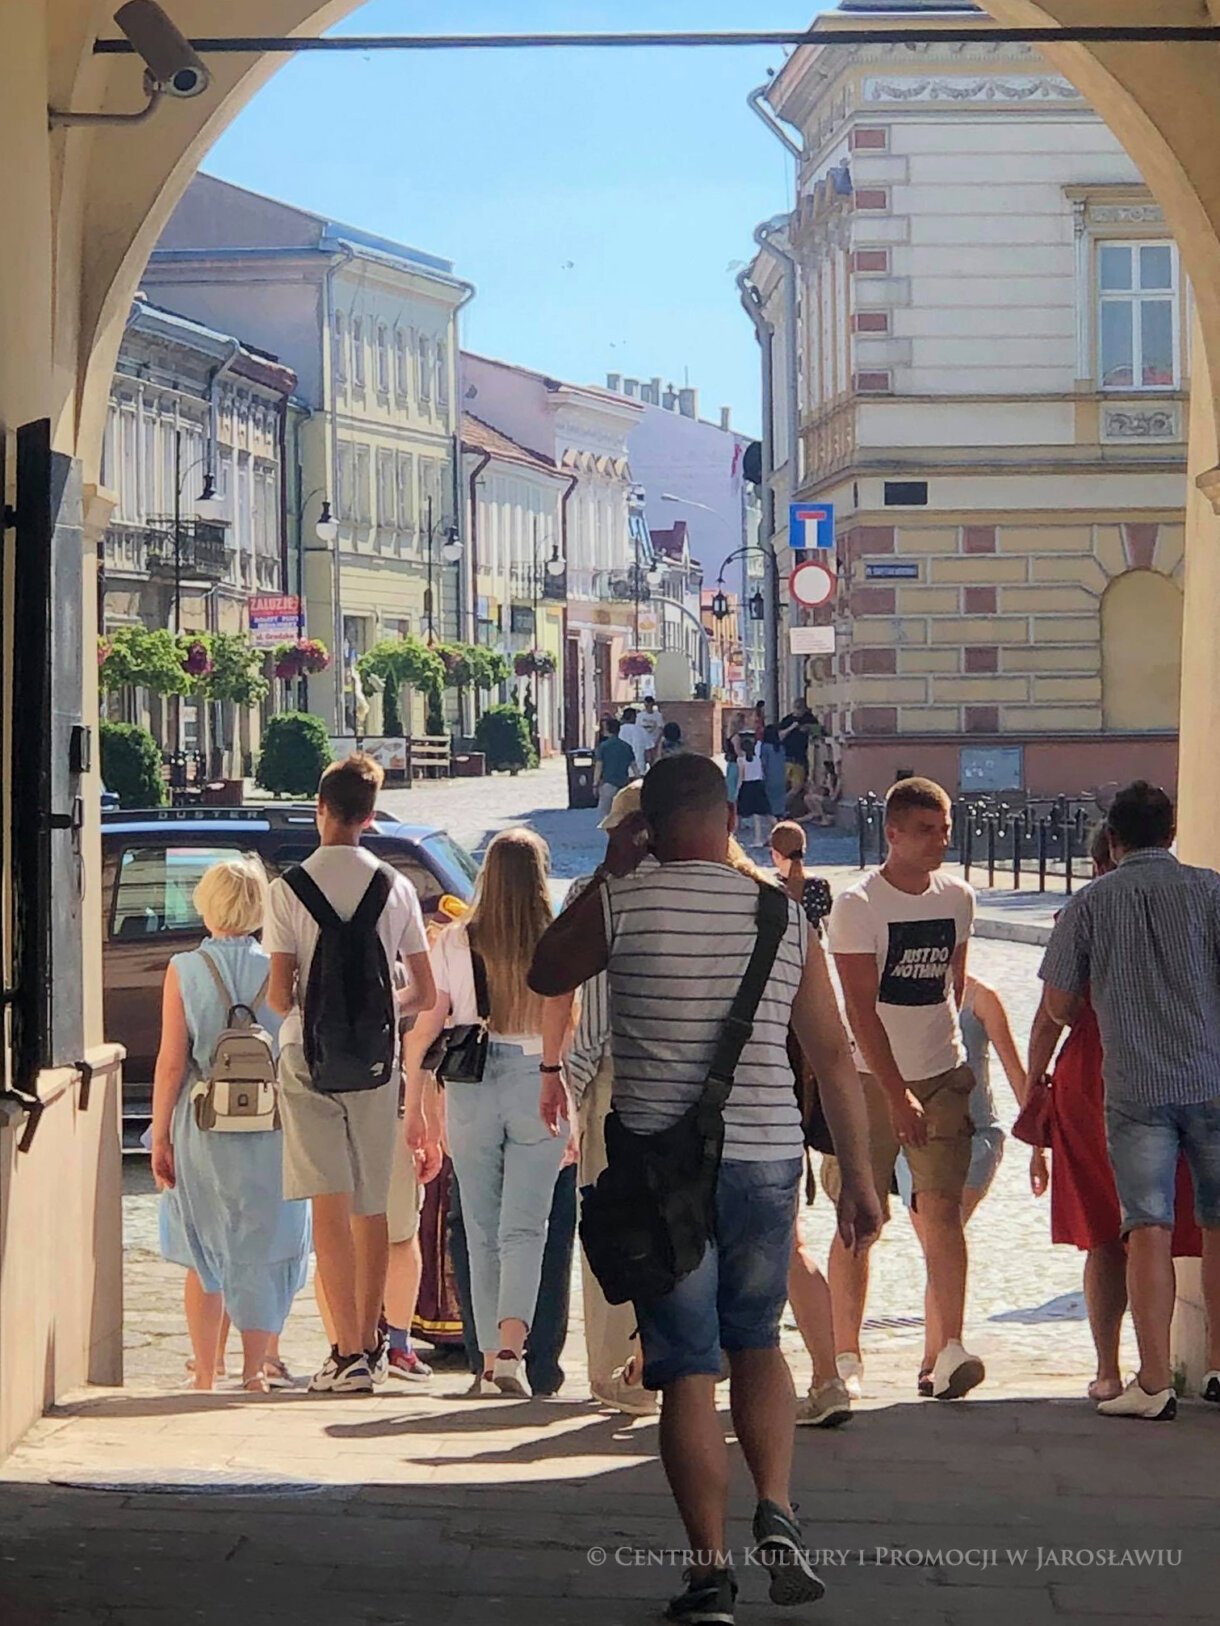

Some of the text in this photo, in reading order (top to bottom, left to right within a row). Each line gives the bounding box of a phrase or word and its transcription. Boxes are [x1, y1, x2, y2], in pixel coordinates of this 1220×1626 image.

[158, 811, 258, 819] DUSTER
[899, 947, 949, 964] JUST DO
